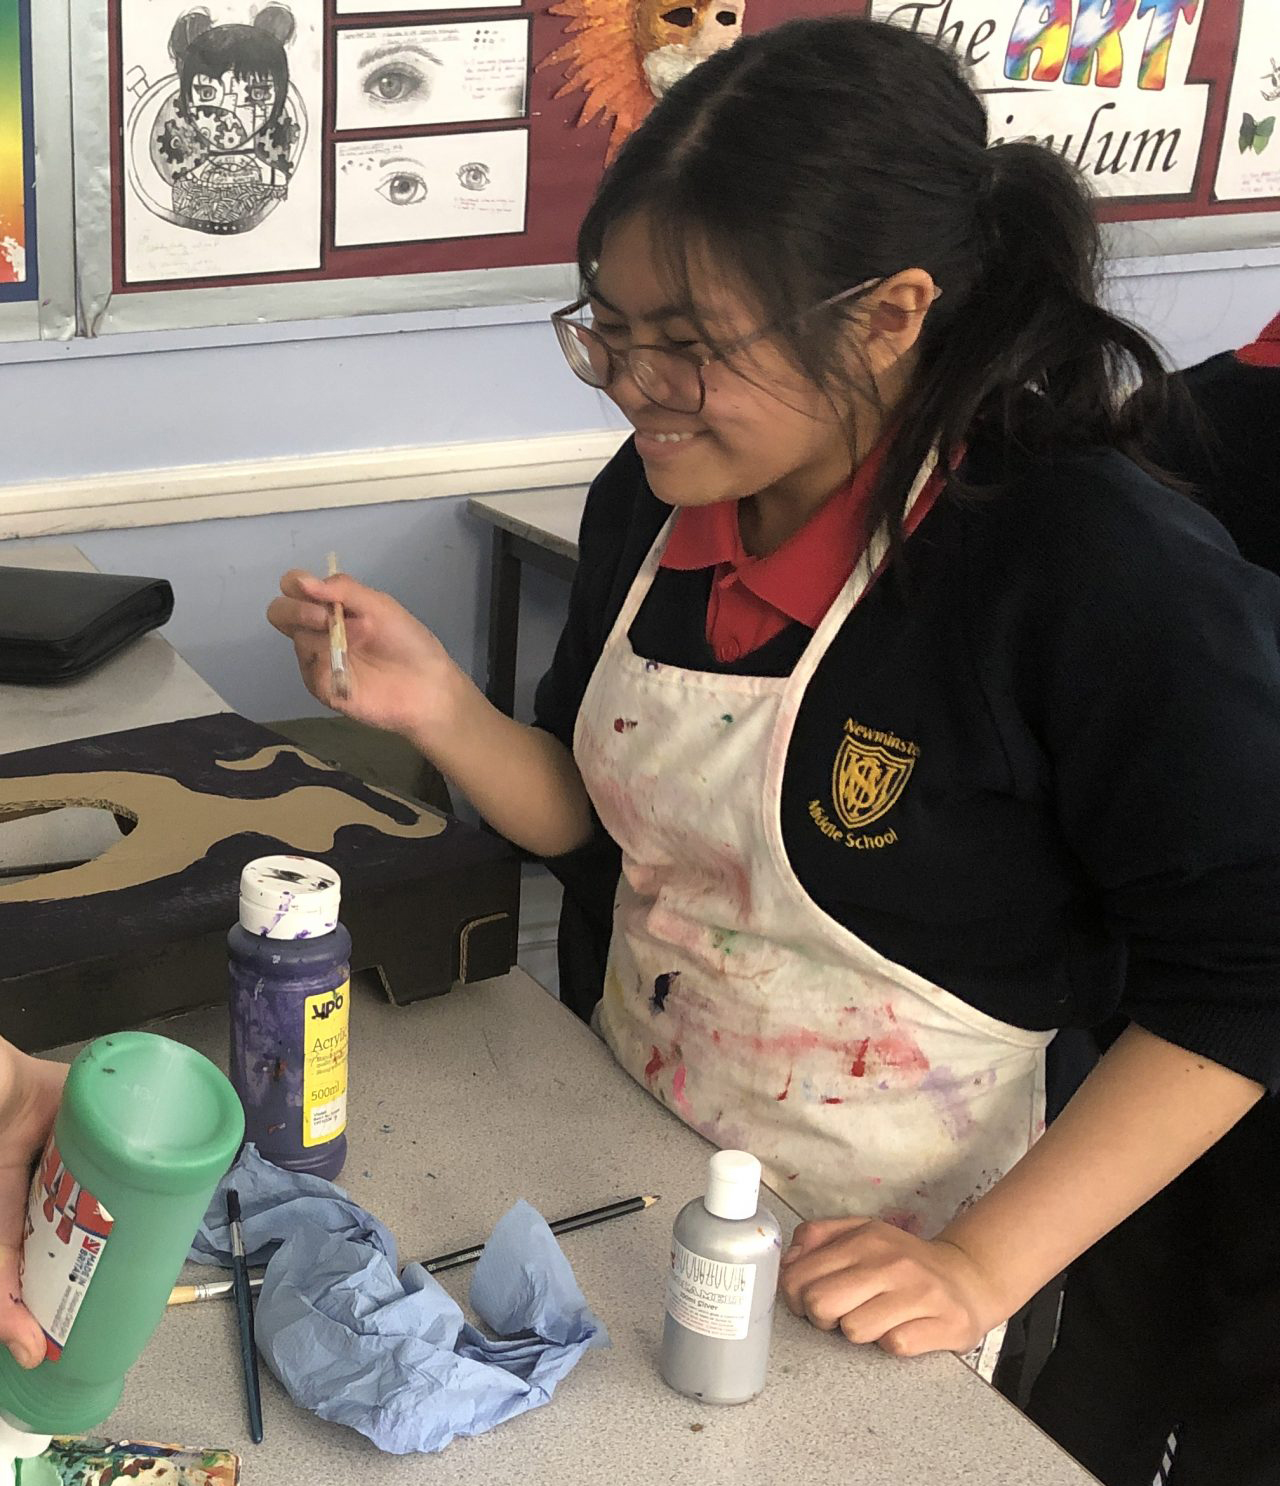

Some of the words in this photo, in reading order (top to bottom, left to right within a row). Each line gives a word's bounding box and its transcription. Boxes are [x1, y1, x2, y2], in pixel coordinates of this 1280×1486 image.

[886, 0, 996, 66] The
[1004, 0, 1197, 90] ART
[808, 799, 844, 842] Middle
[845, 826, 898, 849] School
[311, 1081, 340, 1101] 500ml
